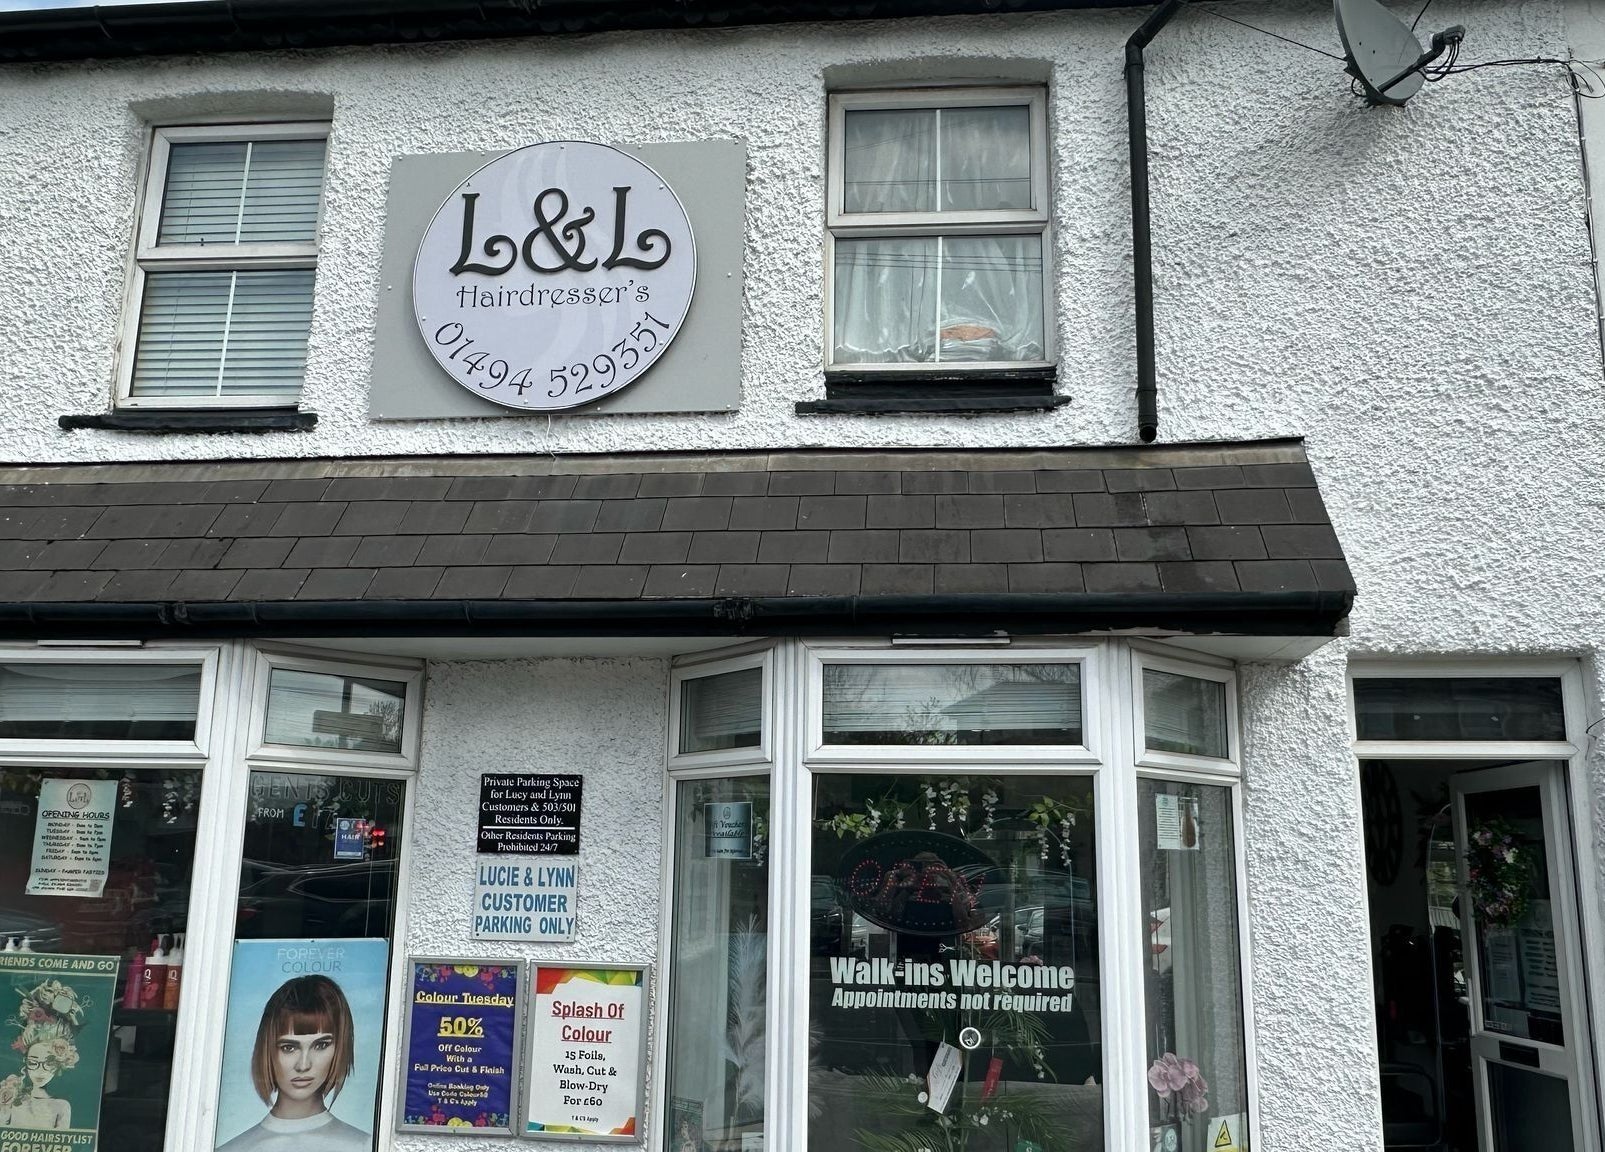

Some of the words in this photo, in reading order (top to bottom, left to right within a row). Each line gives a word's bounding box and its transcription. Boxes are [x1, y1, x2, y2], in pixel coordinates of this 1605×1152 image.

[449, 186, 672, 276] L&L
[456, 280, 650, 309] Hairdresser's
[435, 322, 533, 396] 01494
[548, 312, 670, 398] 529351
[484, 777, 514, 787] Private
[517, 778, 550, 790] Parking
[552, 778, 580, 789] Space
[490, 789, 504, 798] for
[505, 790, 527, 800] Lucy
[530, 790, 546, 799] and
[549, 790, 572, 800] Lynn
[258, 807, 284, 818] FROM
[482, 802, 528, 812] Customers
[530, 802, 540, 812] &
[542, 803, 576, 812] 503/501
[42, 810, 80, 818] OPENING
[495, 814, 538, 824] Residents
[540, 815, 564, 826] Only.
[480, 831, 504, 840] Other
[505, 831, 544, 840] Residents
[546, 832, 576, 842] Parking
[498, 842, 538, 852] Prohibited
[540, 843, 558, 852] 24/7
[480, 866, 520, 886] LUCIE
[524, 867, 533, 886] &
[538, 866, 574, 888] LYNN
[482, 892, 568, 913] CUSTOMER
[476, 916, 532, 933] PARKING
[540, 917, 574, 934] ONLY
[277, 948, 344, 960] FOREVER
[0, 957, 35, 968] RIENDS
[38, 958, 68, 968] COME
[71, 960, 94, 970] AND
[97, 961, 114, 971] GO
[282, 960, 342, 974] COLOUR
[830, 956, 944, 986] Walk-ins
[950, 959, 1075, 989] Welcome
[416, 990, 458, 1003] Colour
[462, 992, 514, 1008] Tuesday
[832, 987, 956, 1010] Appointments
[960, 992, 990, 1010] not
[993, 992, 1072, 1013] required
[552, 1000, 602, 1020] Splash
[607, 1003, 624, 1018] Of
[439, 1016, 484, 1036] 50%
[562, 1024, 612, 1042] Colour
[438, 1044, 453, 1052] Off
[454, 1044, 482, 1053] Colour
[565, 1050, 576, 1060] 15
[578, 1050, 606, 1062] Foils,
[414, 1063, 429, 1071] Full
[480, 1066, 505, 1074] Finish
[553, 1064, 584, 1075] Wash,
[586, 1066, 606, 1076] Cut
[608, 1067, 617, 1076] &
[560, 1080, 608, 1093] Blow-Dry
[564, 1095, 582, 1106] For
[584, 1097, 603, 1106] £60
[1, 1130, 28, 1141] GOOD
[30, 1132, 93, 1144] HAIRSTYLIST
